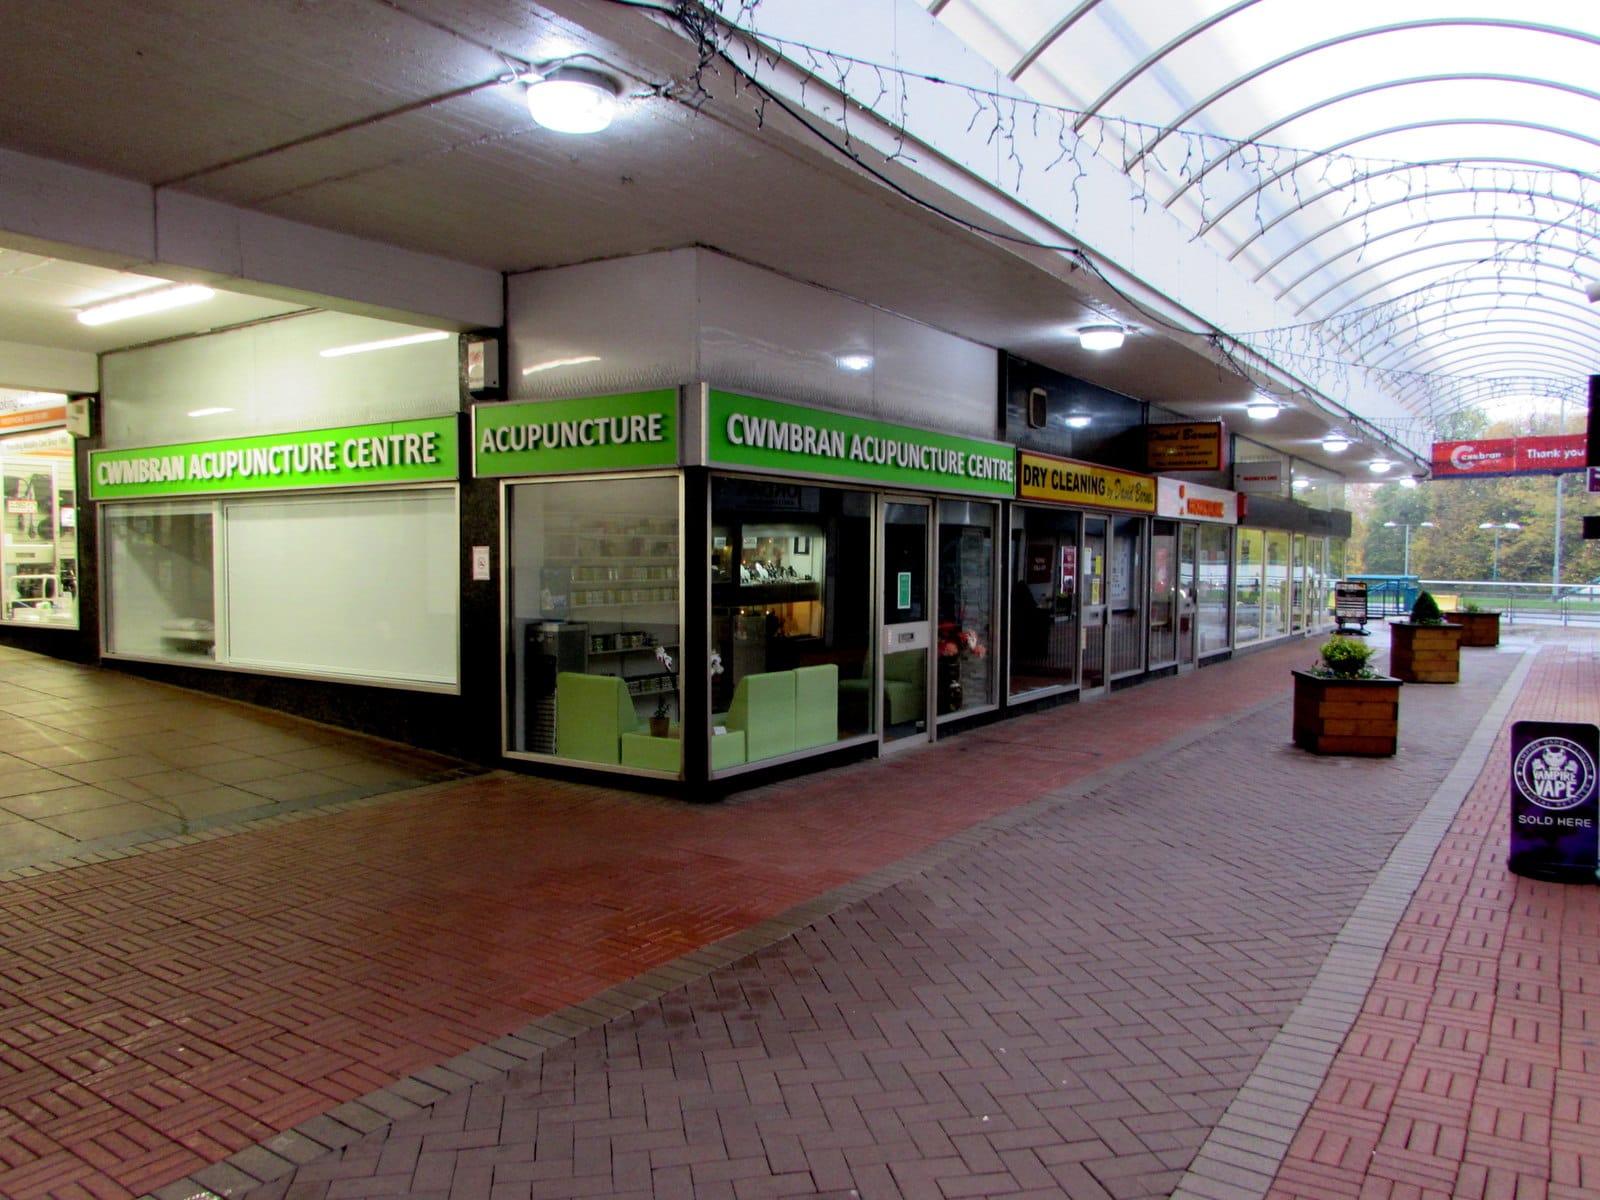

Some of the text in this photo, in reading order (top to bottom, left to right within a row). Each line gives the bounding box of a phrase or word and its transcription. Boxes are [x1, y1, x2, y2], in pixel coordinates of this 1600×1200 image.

[479, 412, 664, 453] ACUPUNCTURE
[726, 412, 1015, 483] CWMBRAN ACUPUNCTURE CENTRE
[96, 431, 438, 487] CWMBRAN ACUPUNCTURE CENTRE
[1527, 448, 1585, 460] Thank you
[1023, 463, 1048, 488] DRY
[1051, 469, 1105, 497] CLEANING
[1534, 769, 1578, 798] VAMPIRE VAPE
[1518, 814, 1592, 828] SOLD HERE
